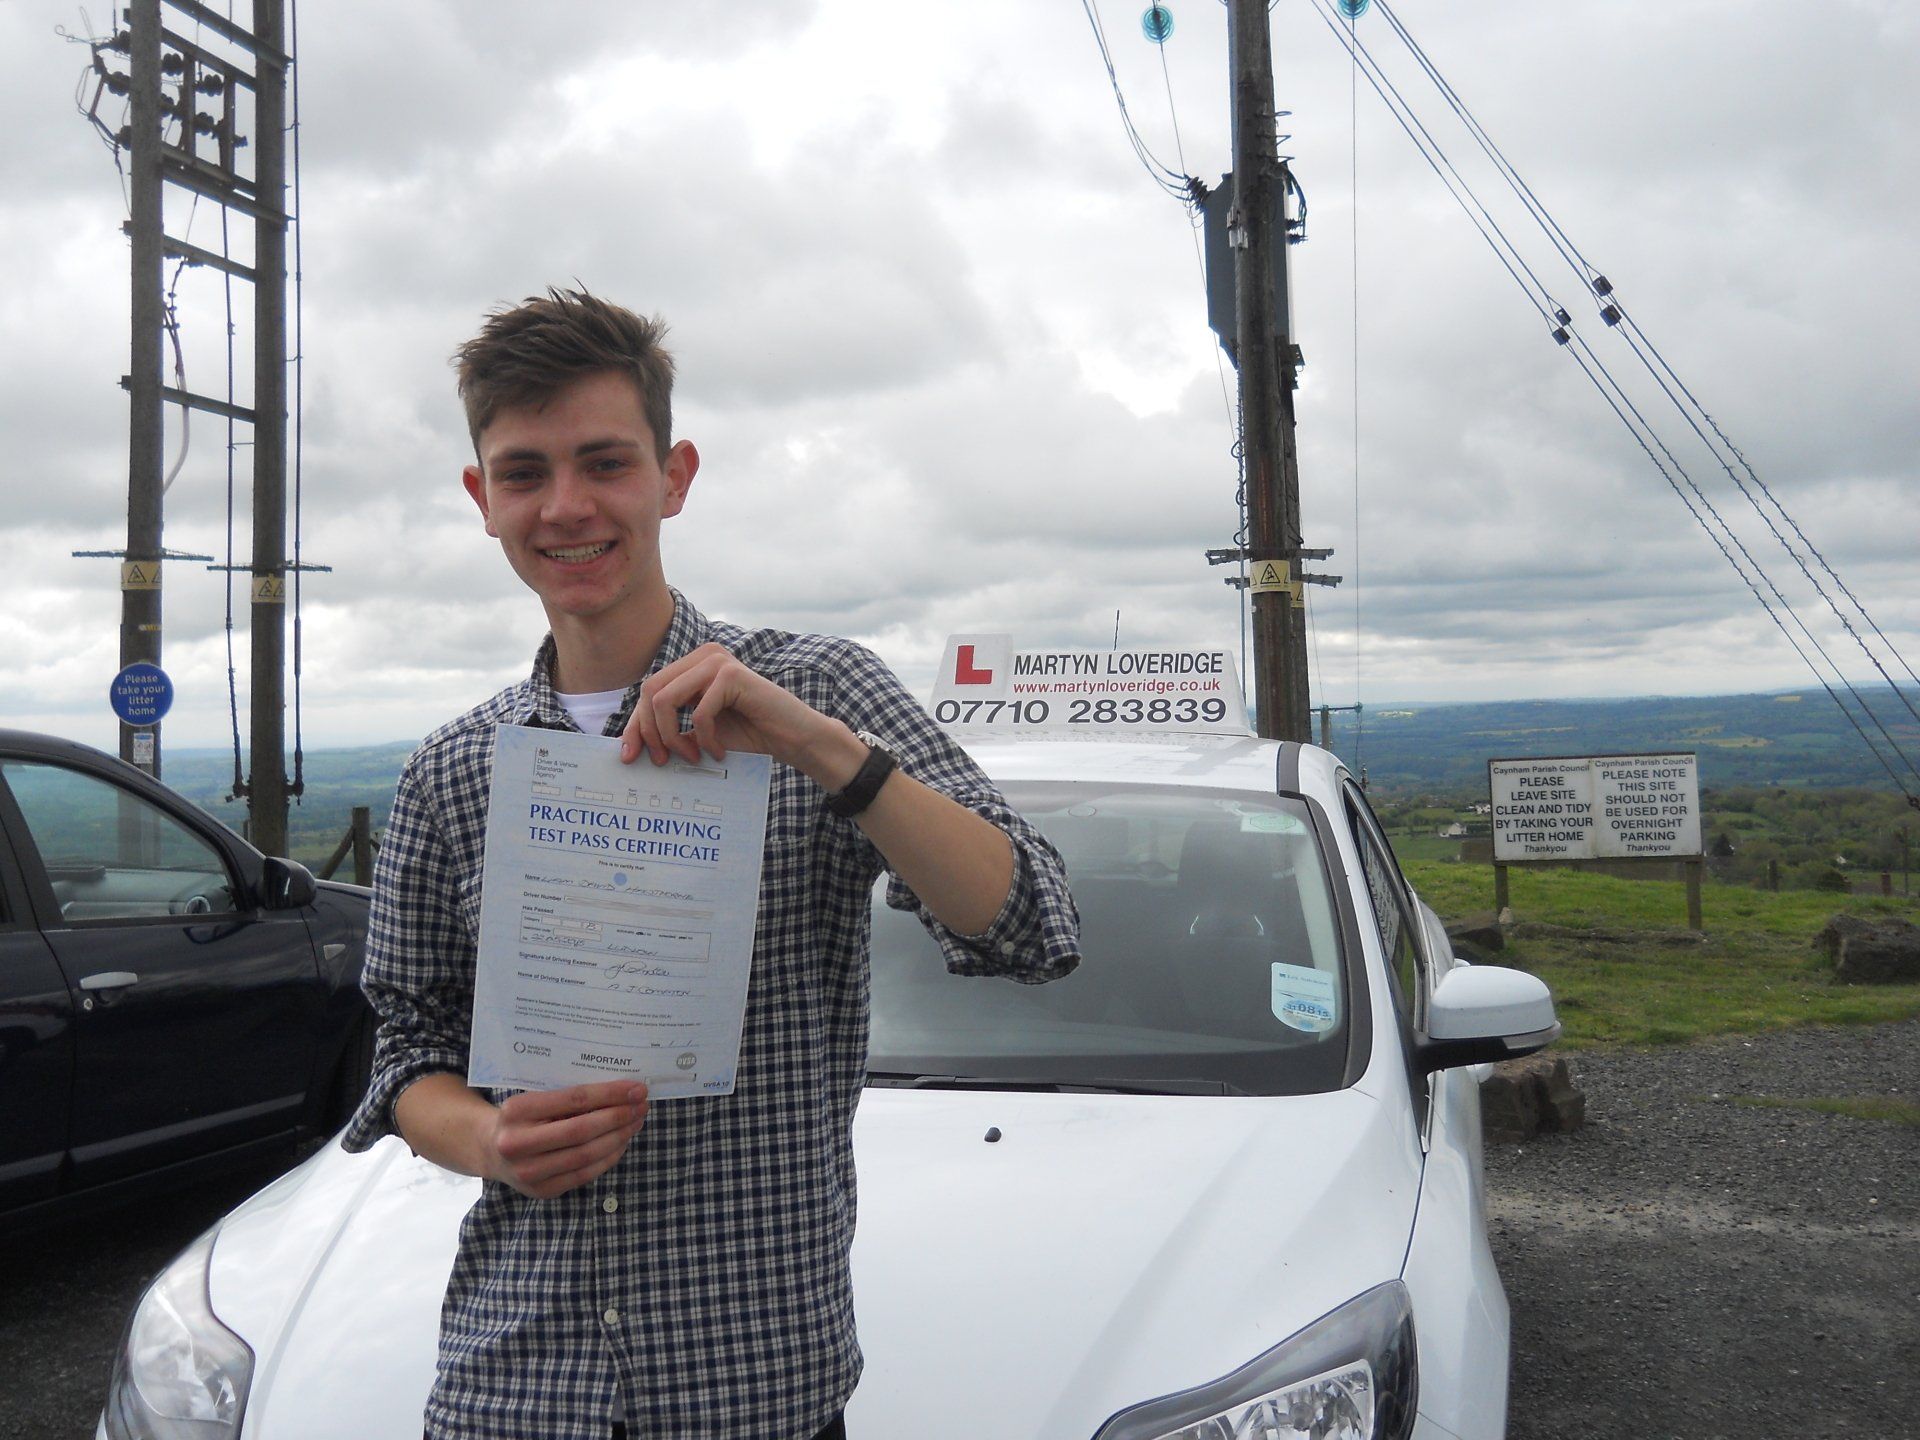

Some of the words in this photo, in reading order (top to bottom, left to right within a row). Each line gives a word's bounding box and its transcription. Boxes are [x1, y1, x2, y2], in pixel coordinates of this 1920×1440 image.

[955, 645, 992, 685] L
[1013, 654, 1098, 675] MARTYN
[1106, 652, 1224, 674] LOVERIDGE
[125, 674, 158, 684] Please
[118, 686, 140, 695] take
[142, 685, 165, 694] your
[1013, 678, 1221, 694] www.martynloveridge.co.uk
[129, 696, 154, 705] litter
[128, 707, 156, 716] home
[935, 700, 1050, 724] 07710
[1067, 698, 1227, 723] 283839
[1594, 759, 1632, 768] Caynham
[1634, 758, 1660, 766] Parish
[1662, 757, 1693, 766] Council
[536, 765, 564, 774] Standards
[1493, 766, 1529, 775] Caynham
[1532, 765, 1558, 773] Parish
[1560, 764, 1590, 772] Council
[1602, 770, 1649, 780] PLEASE
[1652, 769, 1686, 778] NOTE
[536, 771, 557, 780] Agency
[1520, 777, 1564, 787] PLEASE
[1618, 782, 1646, 792] THIS
[1649, 781, 1676, 790] SITE
[1511, 791, 1547, 801] LEAVE
[1550, 790, 1576, 800] SITE
[1605, 795, 1656, 805] SHOULD
[1660, 794, 1686, 803] NOT
[1496, 806, 1535, 816] CLEAN
[1538, 805, 1562, 814] AND
[1565, 804, 1591, 814] TIDY
[1605, 808, 1622, 817] BE
[1625, 807, 1658, 816] USED
[1662, 806, 1687, 815] FOR
[530, 803, 630, 830] PRACTICAL
[637, 817, 722, 841] DRIVING
[1496, 820, 1510, 829] BY
[1514, 818, 1557, 828] TAKING
[1559, 817, 1593, 827] YOUR
[1611, 818, 1682, 829] OVERNIGHT
[1506, 832, 1545, 842] LITTER
[1549, 832, 1584, 842] HOME
[1620, 832, 1676, 842] PARKING
[529, 826, 566, 844] TEST
[571, 832, 610, 850] PASS
[615, 838, 720, 862] CERTIFICATE
[1524, 844, 1567, 854] Thankyou
[1626, 844, 1671, 852] Thankyou
[534, 906, 554, 914] Passed
[519, 952, 544, 960] Signature
[552, 956, 572, 964] Driving
[540, 974, 560, 982] Driving
[580, 1053, 632, 1066] IMPORTANT
